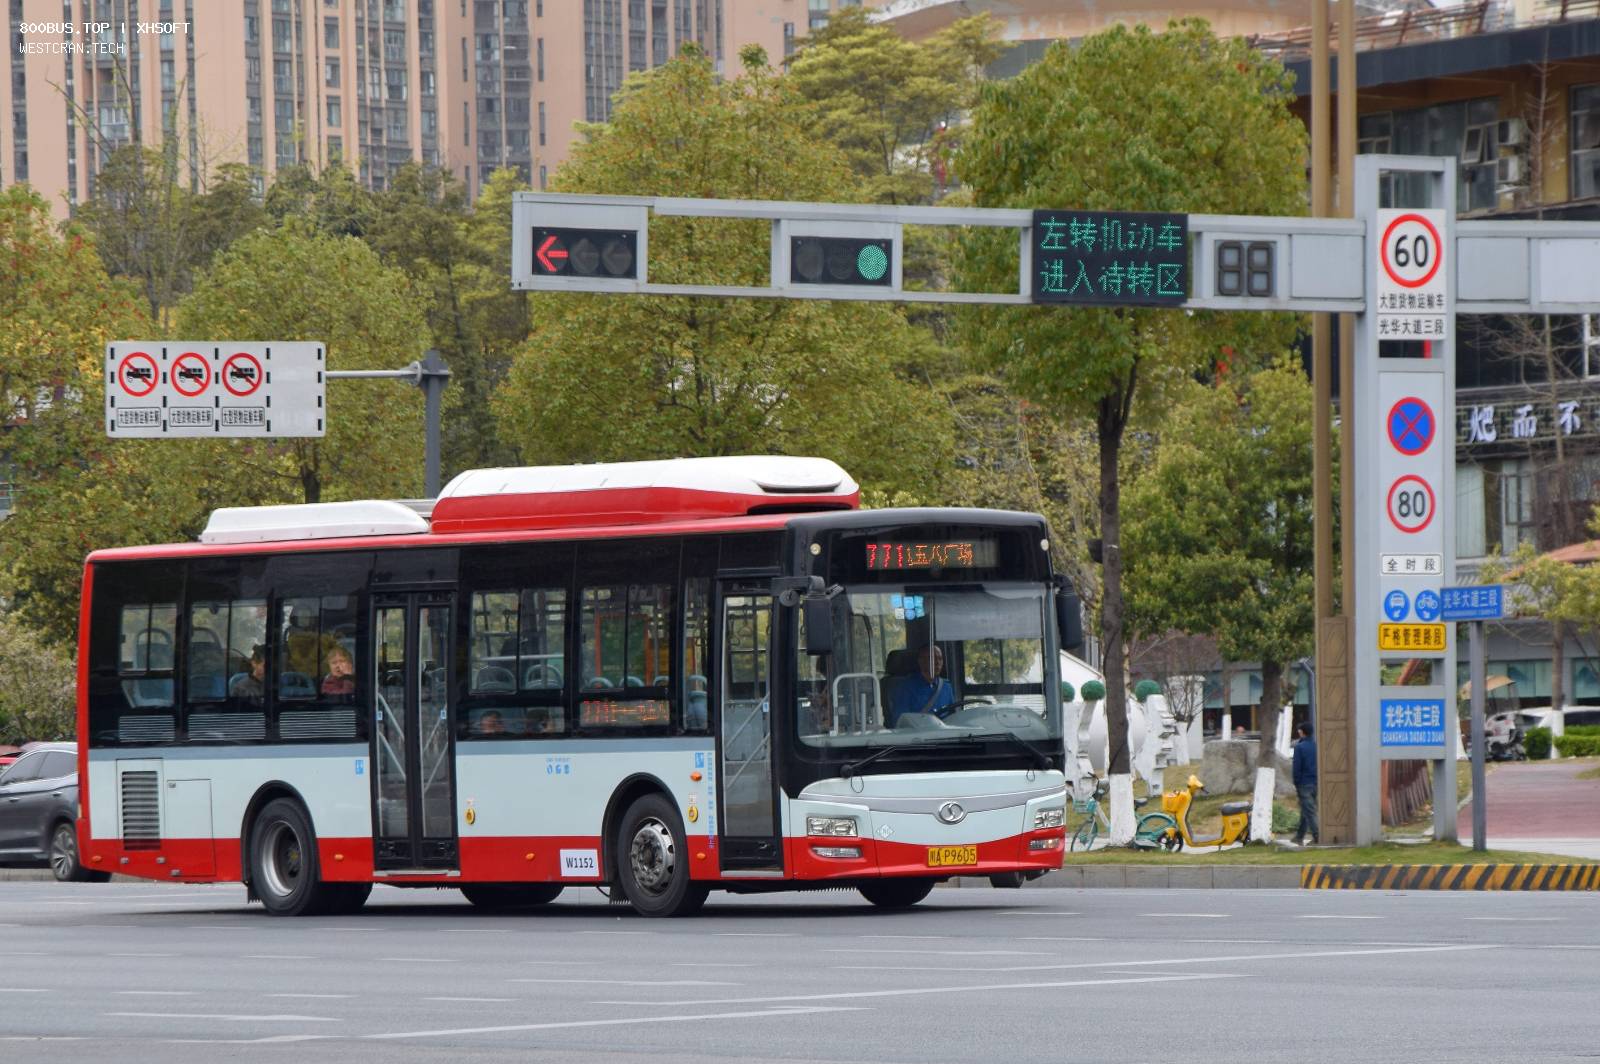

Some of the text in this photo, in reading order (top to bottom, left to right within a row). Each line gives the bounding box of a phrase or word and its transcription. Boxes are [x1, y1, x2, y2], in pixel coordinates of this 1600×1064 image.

[1040, 215, 1184, 252] 左转机动车
[1394, 234, 1429, 268] 60
[1039, 258, 1185, 296] 进入待转区
[1379, 293, 1444, 309] 大型货物运输车
[1379, 318, 1444, 335] 光华大道三段
[1398, 490, 1426, 518] 80
[1386, 557, 1437, 572] 全时段
[1385, 704, 1441, 728] 光华大道三段
[565, 857, 594, 868] W1152
